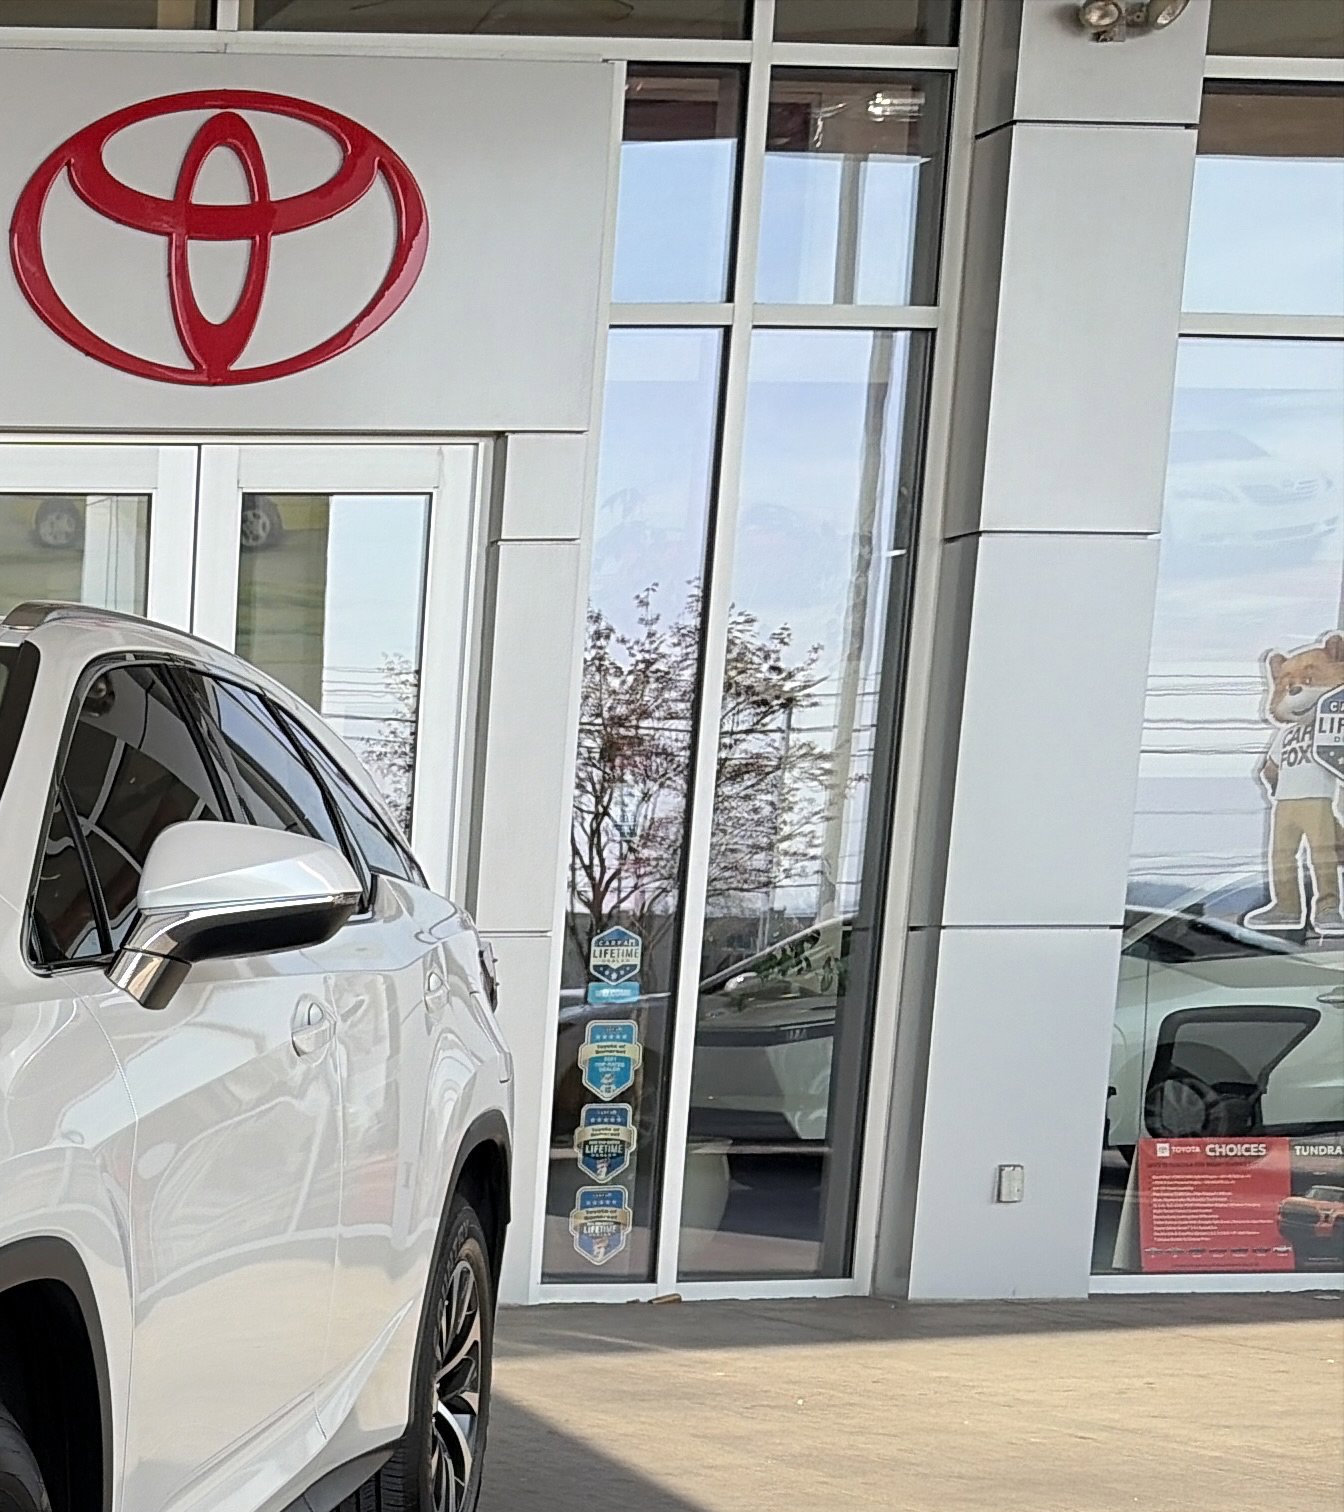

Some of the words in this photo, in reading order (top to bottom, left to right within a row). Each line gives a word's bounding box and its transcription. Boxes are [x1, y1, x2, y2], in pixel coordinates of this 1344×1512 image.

[1281, 745, 1312, 768] FOX
[593, 948, 639, 958] LIFETIME
[585, 1144, 623, 1153] LIFETIME
[1205, 1144, 1266, 1156] CHOICES
[1295, 1145, 1343, 1155] TUNDRA
[583, 1225, 616, 1234] LIFETIME
